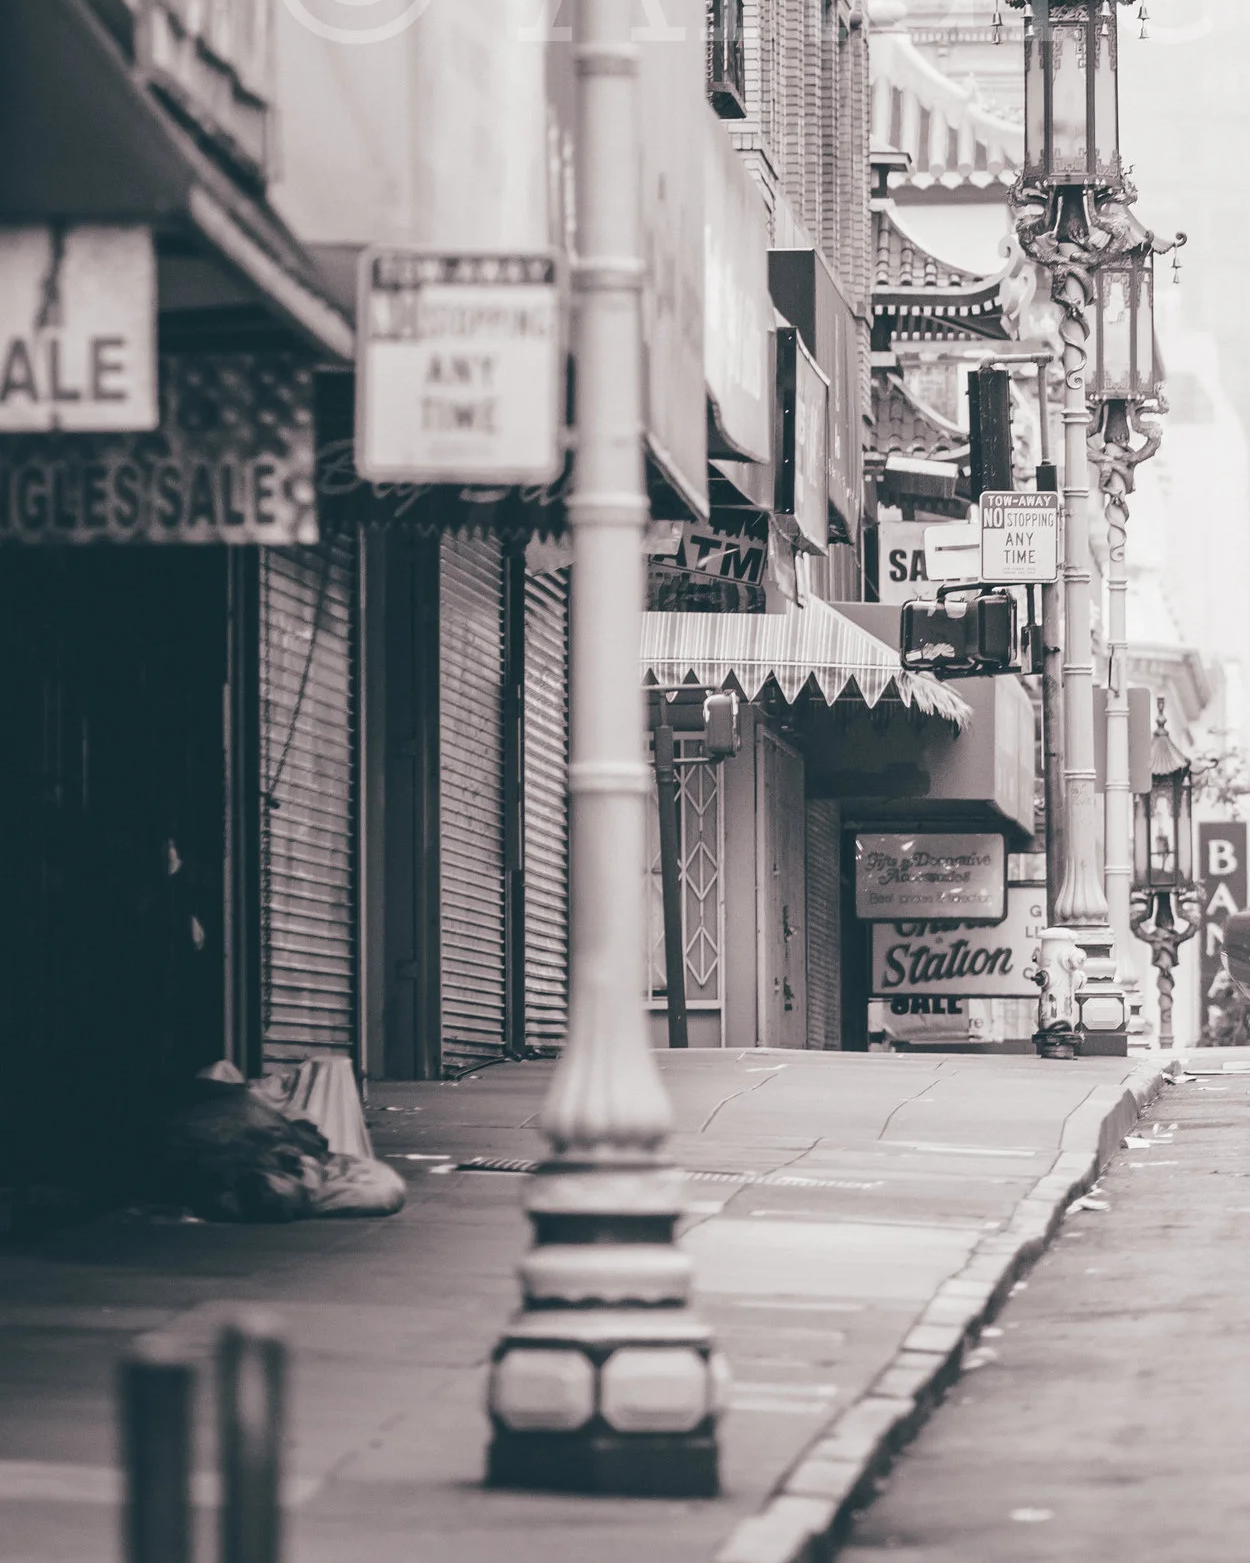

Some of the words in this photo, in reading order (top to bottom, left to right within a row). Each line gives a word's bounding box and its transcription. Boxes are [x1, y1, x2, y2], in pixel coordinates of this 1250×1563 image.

[425, 351, 496, 383] ANY
[421, 395, 498, 435] TIME
[152, 460, 277, 529] SALE
[988, 495, 1052, 507] TOW-AWAY
[983, 507, 1004, 528] NO
[1006, 512, 1054, 527] STOPPING
[1005, 532, 1034, 546] ANY
[1004, 549, 1036, 564] TIME
[881, 938, 1015, 989] Station
